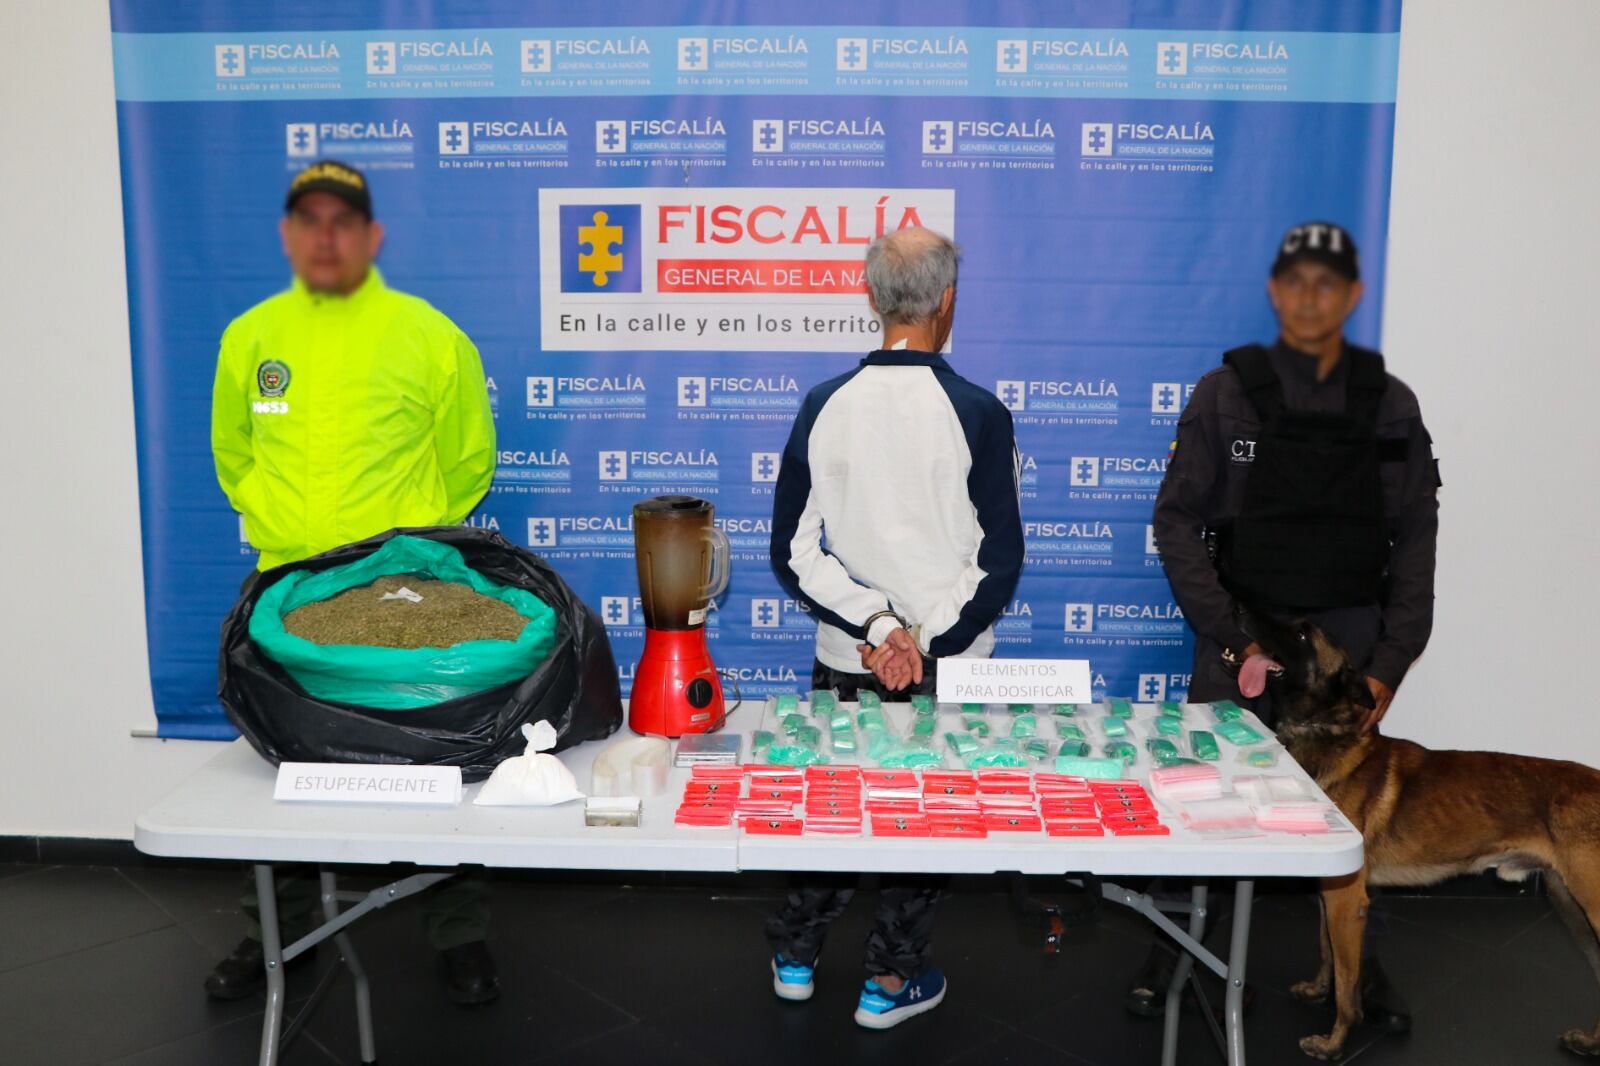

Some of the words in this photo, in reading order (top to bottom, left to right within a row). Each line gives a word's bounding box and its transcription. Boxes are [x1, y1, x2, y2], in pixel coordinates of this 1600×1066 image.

[248, 41, 339, 59] FISCALÍA
[400, 39, 492, 57] FISCALÍA
[555, 36, 649, 55] FISCALÍA
[712, 35, 808, 53] FISCALÍA
[872, 36, 968, 55] FISCALÍA
[1032, 38, 1128, 57] FISCALÍA
[1192, 40, 1288, 60] FISCALÍA
[473, 118, 567, 136] FISCALÍA
[631, 118, 725, 135] FISCALÍA
[788, 117, 885, 136] FISCALÍA
[958, 118, 1054, 138] FISCALÍA
[1117, 121, 1214, 140] FISCALÍA
[452, 160, 460, 168] la
[463, 160, 484, 168] calle
[508, 160, 521, 168] los
[524, 160, 568, 168] territorios
[823, 159, 836, 167] los
[935, 160, 943, 168] la
[946, 160, 968, 168] calle
[992, 161, 1005, 169] los
[1008, 161, 1054, 169] territorios
[1151, 163, 1164, 171] los
[1167, 164, 1213, 172] territorios
[1283, 223, 1343, 252] CTI
[664, 268, 767, 286] GENERAL
[774, 269, 803, 286] DE
[809, 269, 835, 286] LA
[560, 314, 586, 332] En
[597, 313, 617, 332] la
[628, 313, 686, 332] calle
[697, 318, 708, 337] y
[719, 318, 745, 332] en
[757, 313, 792, 333] los
[803, 314, 880, 334] territo
[557, 374, 645, 391] FISCALÍA
[709, 374, 798, 392] FISCALÍA
[1029, 379, 1118, 396] FISCALÍA
[496, 448, 569, 465] ISCALÍA
[631, 448, 718, 465] FISCALÍA
[1103, 457, 1166, 472] FISCAL
[1134, 492, 1146, 500] los
[559, 515, 632, 531] FISCALÍ
[1025, 521, 1112, 538] FISCALÍA
[1097, 602, 1183, 619] FISCALÍA
[994, 636, 1031, 644] erritorios
[971, 663, 1057, 677] ELEMENTOS
[956, 685, 993, 697] PARA
[998, 685, 1074, 698] DOSIFICAR
[294, 776, 438, 793] ESTUPEFACIENTE
